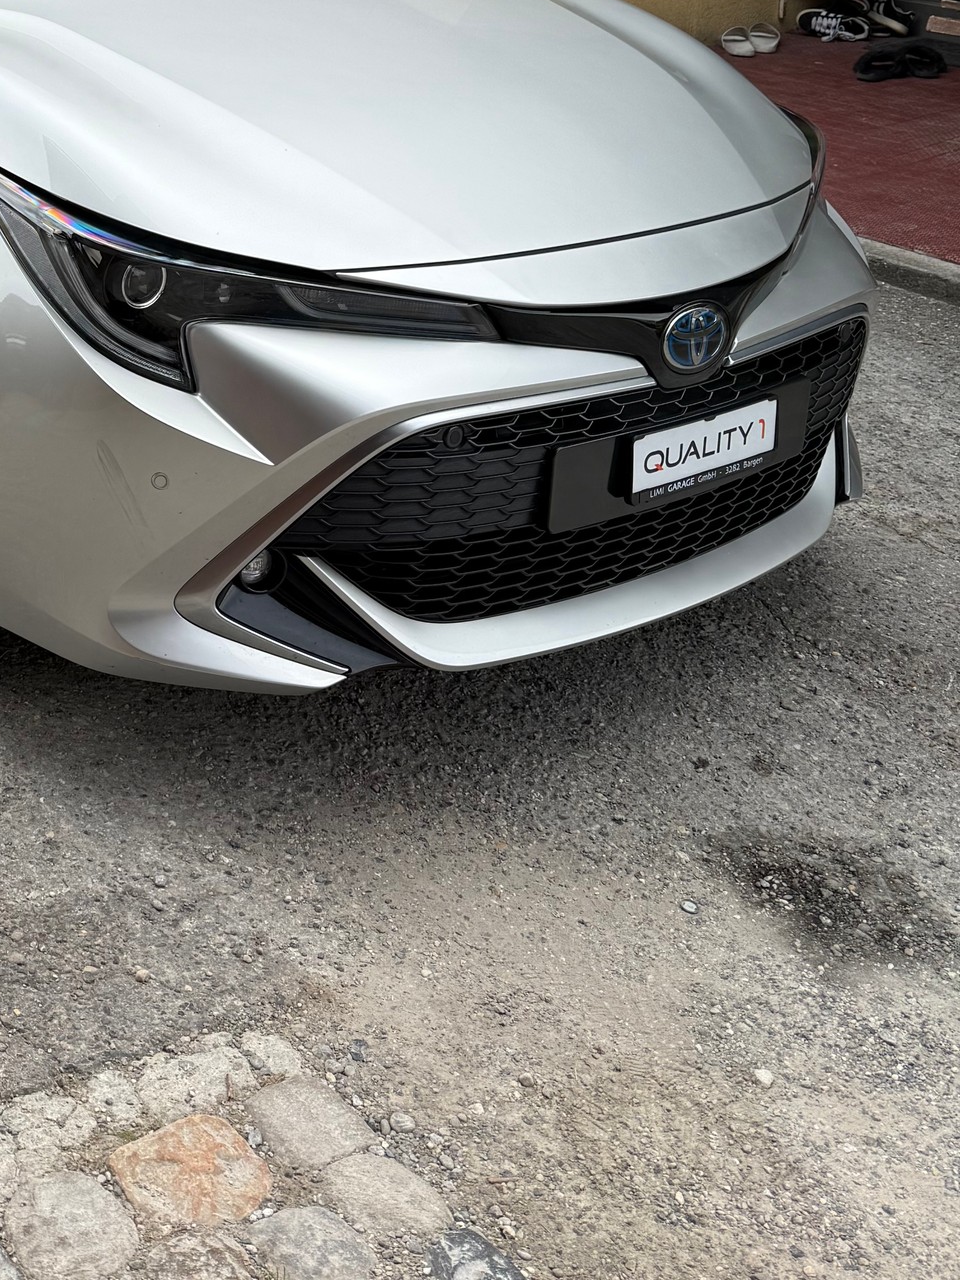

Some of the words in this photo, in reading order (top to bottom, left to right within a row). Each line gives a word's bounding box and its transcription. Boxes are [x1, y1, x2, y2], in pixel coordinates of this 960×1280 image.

[667, 477, 695, 493] GARAGE
[697, 470, 717, 483] GmbH
[725, 462, 741, 475] 3282
[743, 456, 764, 469] Bargen
